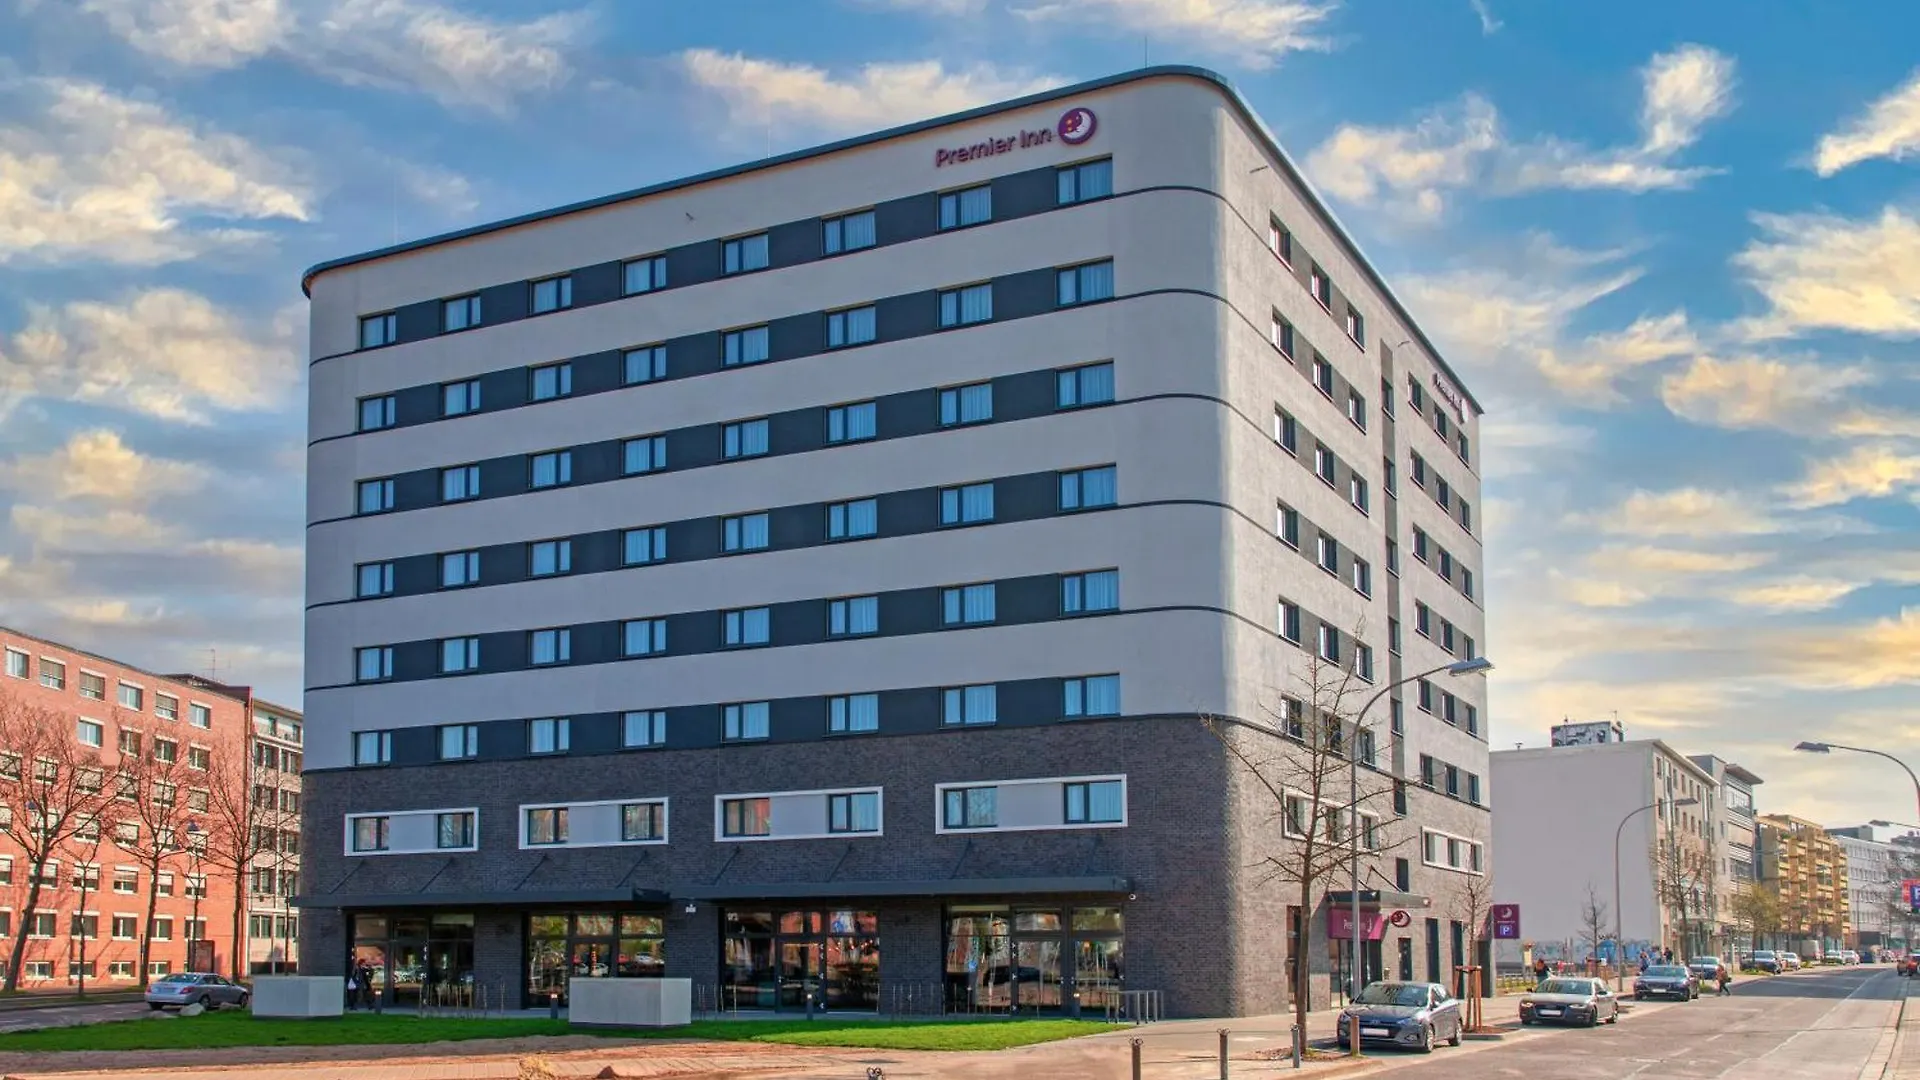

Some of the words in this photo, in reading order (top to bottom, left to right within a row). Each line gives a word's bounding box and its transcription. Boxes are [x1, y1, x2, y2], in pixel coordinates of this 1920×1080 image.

[936, 137, 1016, 168] Premier
[1020, 128, 1053, 149] Inn
[1503, 927, 1510, 936] P
